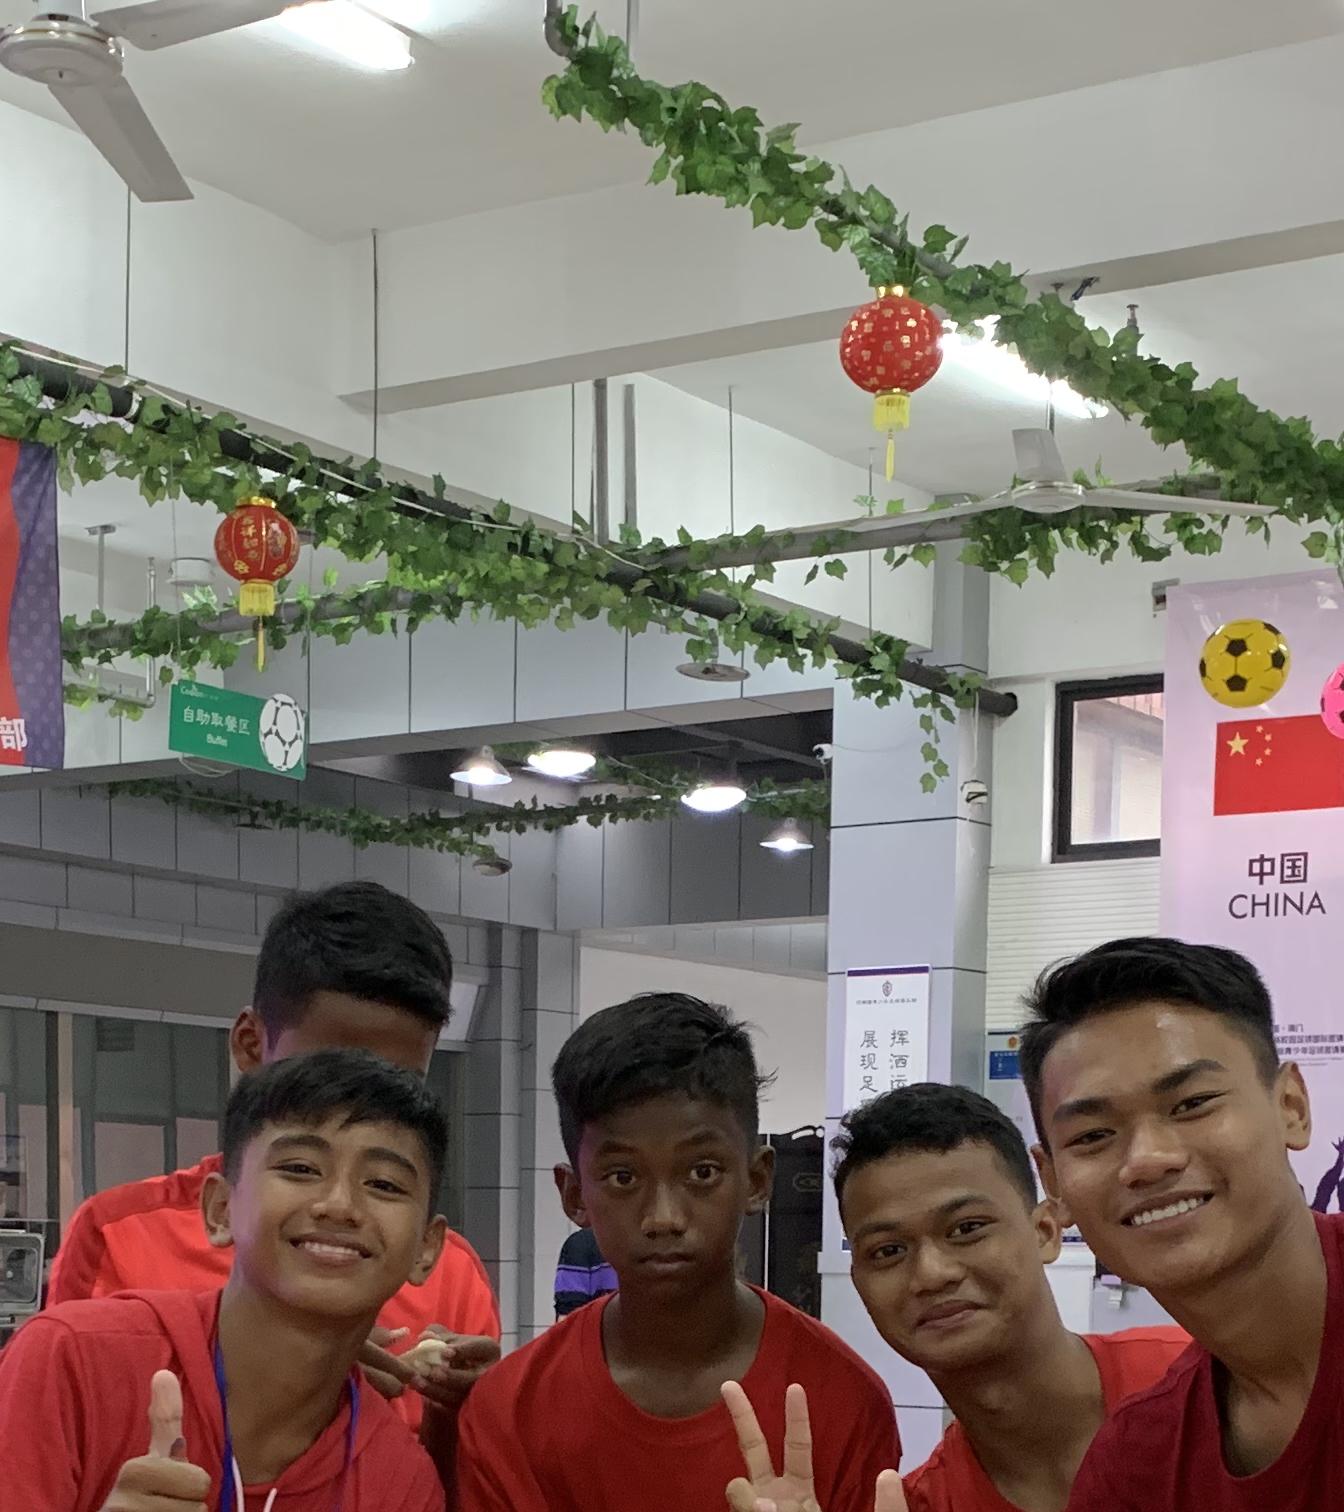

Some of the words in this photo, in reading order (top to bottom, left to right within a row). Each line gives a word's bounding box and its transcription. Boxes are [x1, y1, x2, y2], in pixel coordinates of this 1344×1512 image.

[183, 705, 251, 736] 自助取餐区
[1248, 852, 1309, 886] 中国
[1227, 890, 1327, 920] CHINA
[859, 1030, 879, 1106] 展现足
